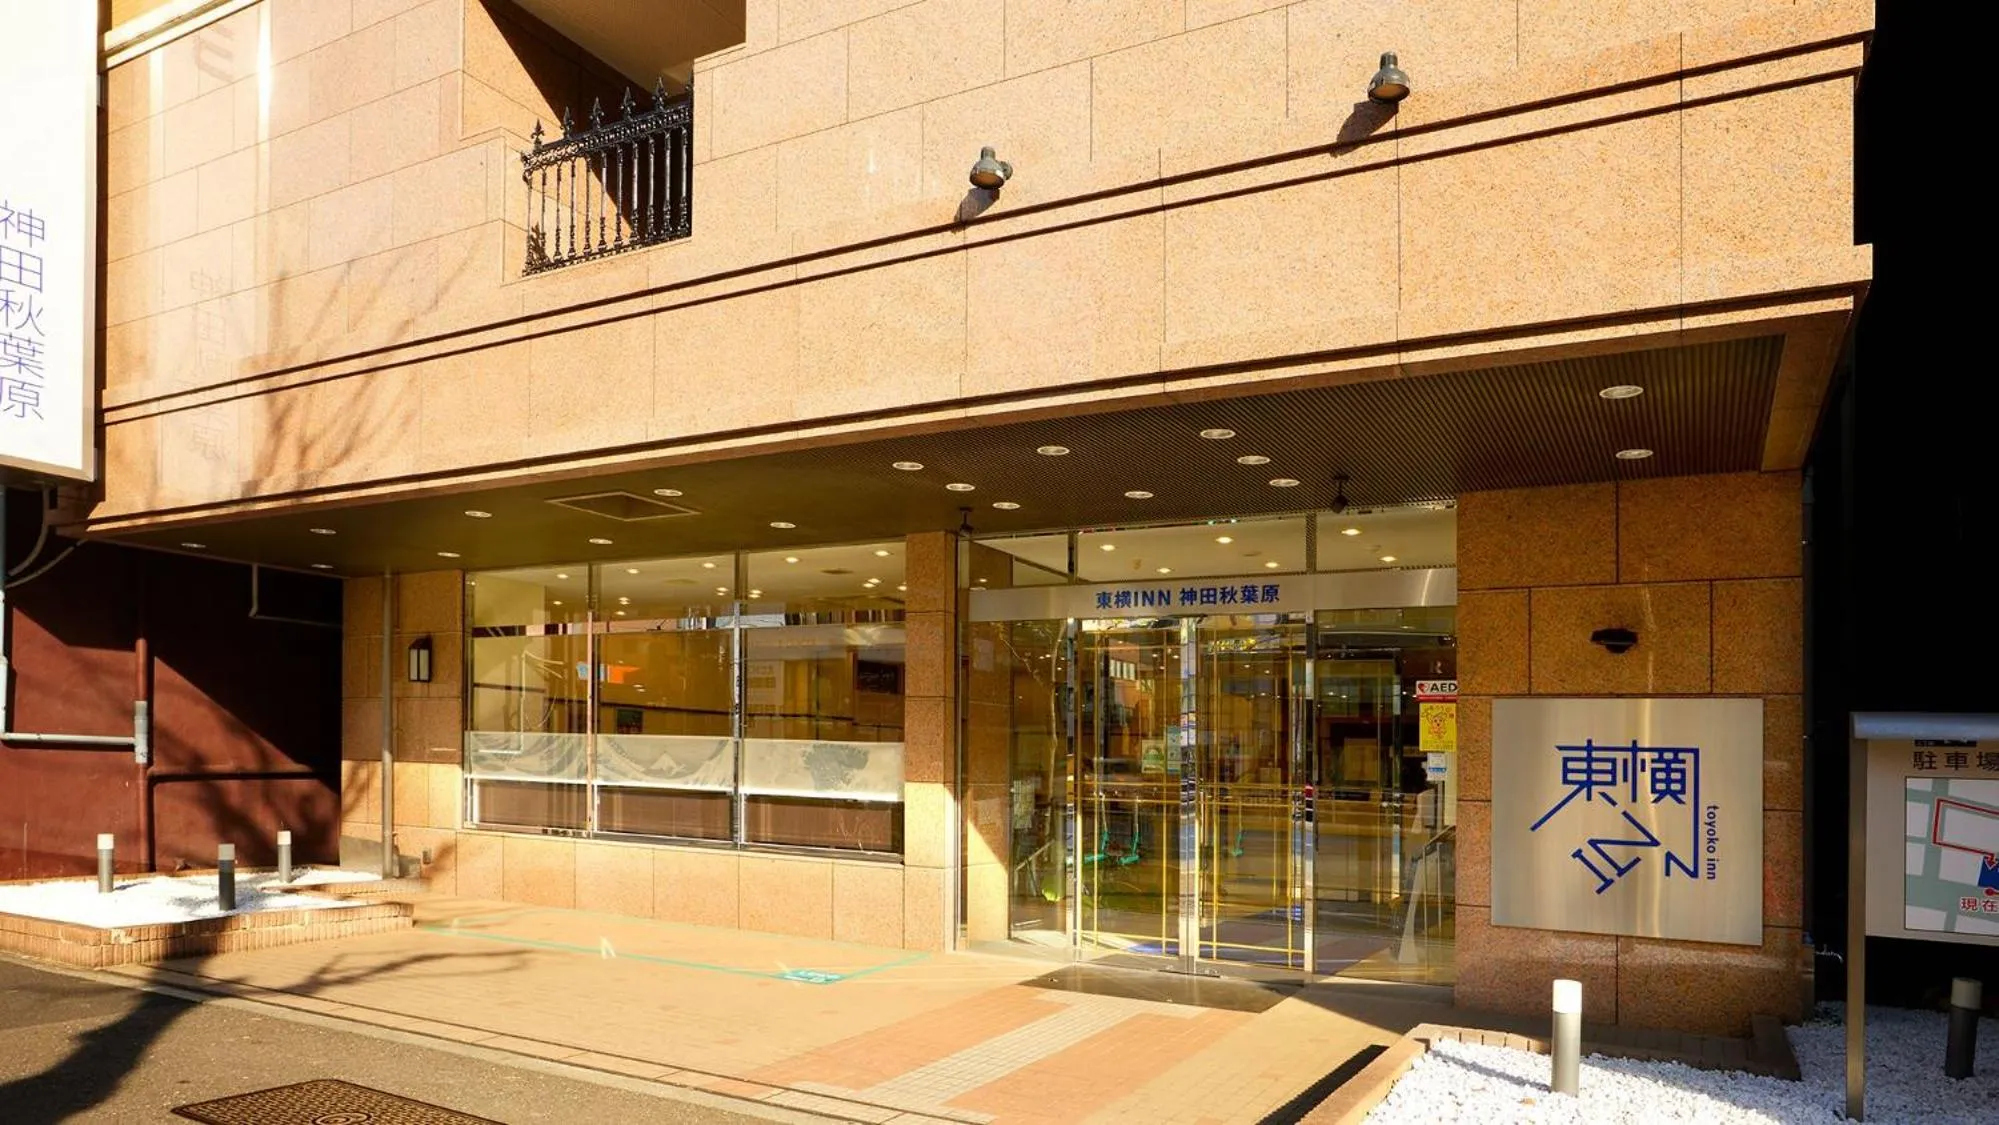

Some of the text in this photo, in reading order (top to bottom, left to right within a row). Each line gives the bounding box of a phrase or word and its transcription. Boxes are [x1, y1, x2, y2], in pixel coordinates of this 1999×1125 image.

[0, 199, 45, 420] 神田秋葉原
[1096, 584, 1280, 609] 東横INN 神田秋葉原
[1429, 682, 1458, 693] AED
[1913, 751, 1999, 771] 駐車場
[1704, 804, 1720, 880] toyoko inn
[1960, 897, 1999, 912] 現在
